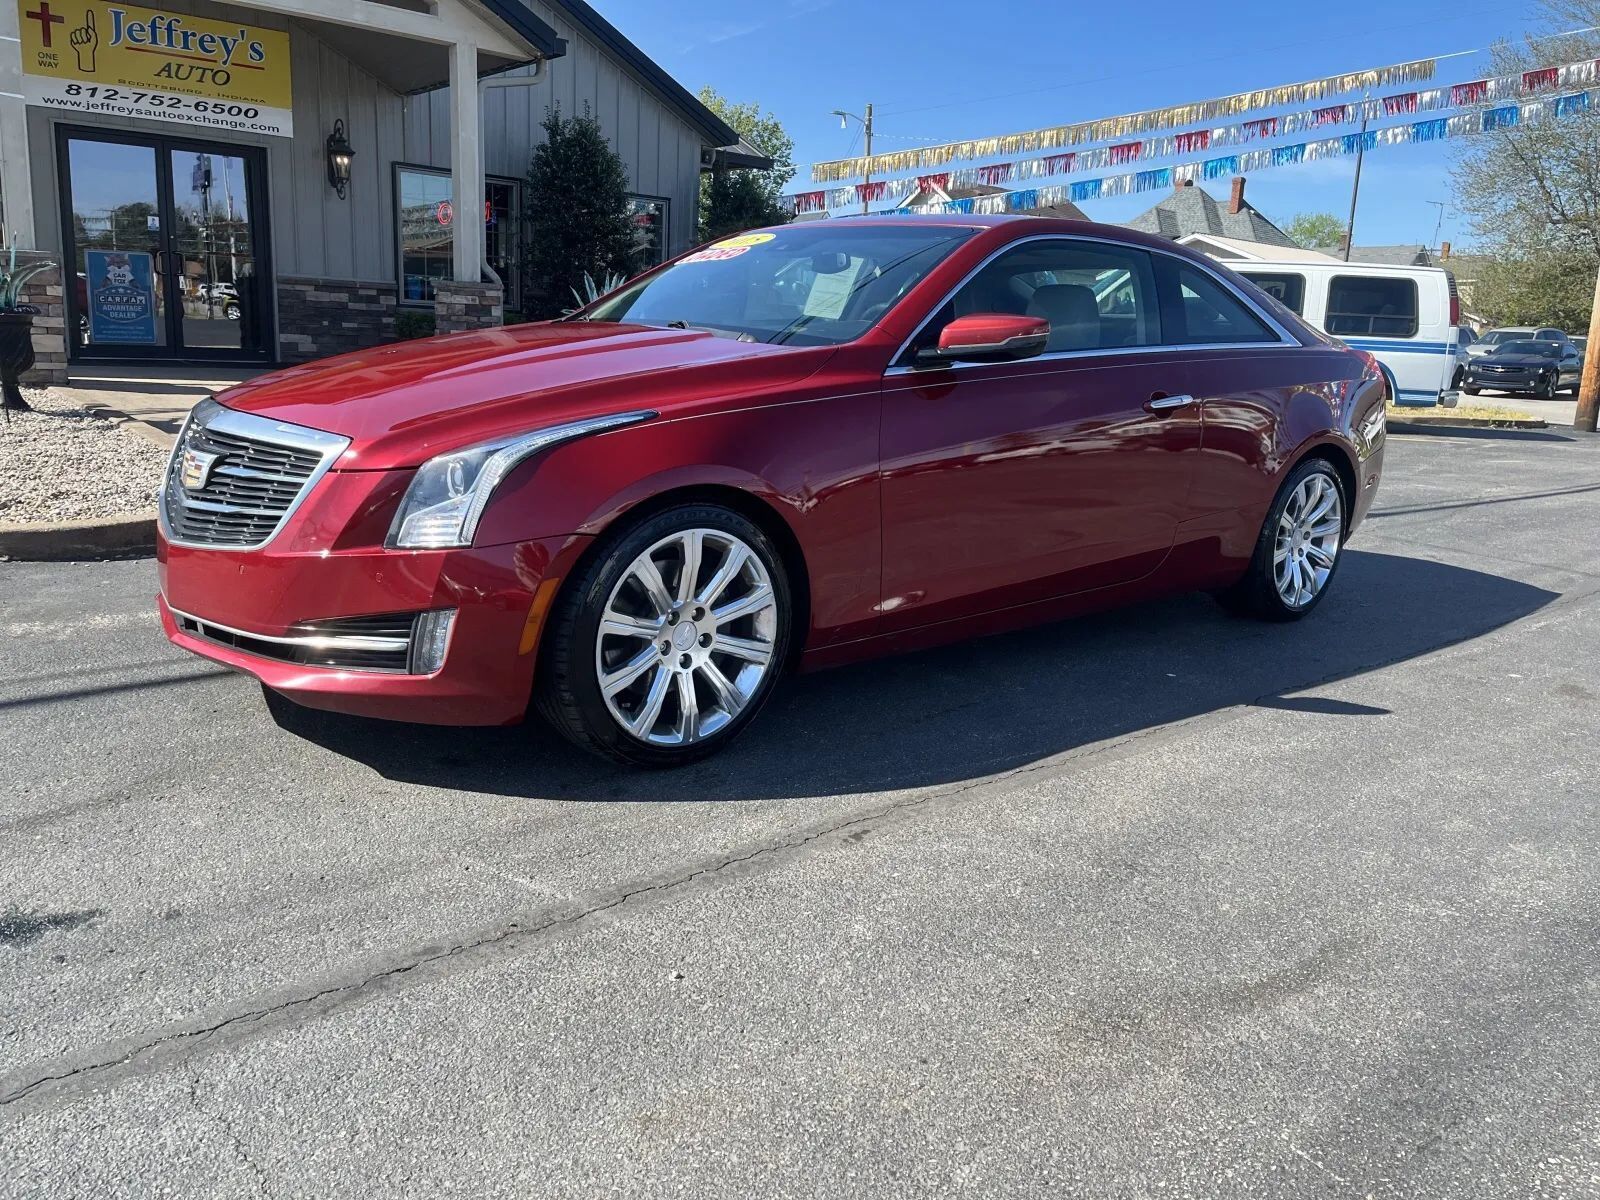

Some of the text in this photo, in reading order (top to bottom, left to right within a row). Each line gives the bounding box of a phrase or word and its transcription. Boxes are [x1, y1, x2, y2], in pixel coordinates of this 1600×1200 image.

[108, 8, 265, 66] Jeffrey's
[38, 51, 59, 60] ONE
[38, 60, 59, 68] WAY
[153, 62, 231, 86] AUTO
[65, 84, 259, 119] 812-752-6500
[217, 92, 266, 103] INDIANA
[42, 97, 281, 133] www.jeffreysautoexchange.com
